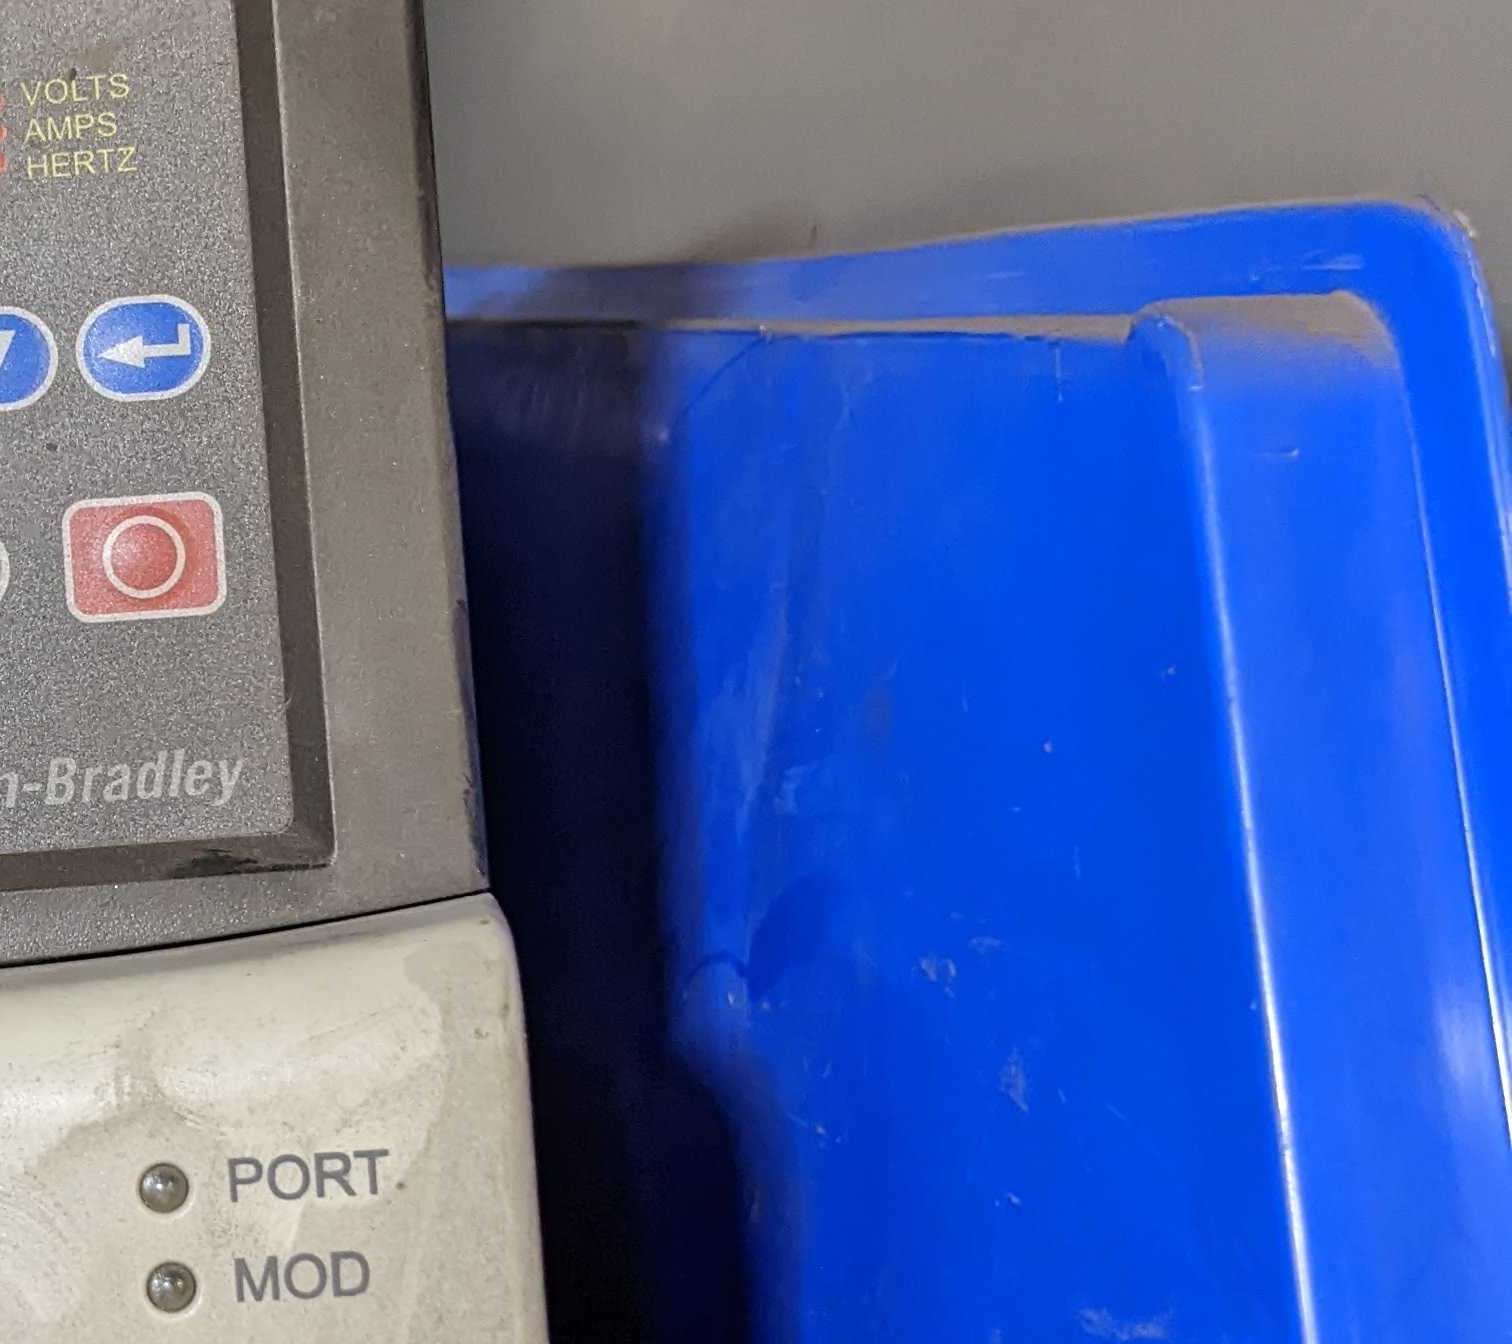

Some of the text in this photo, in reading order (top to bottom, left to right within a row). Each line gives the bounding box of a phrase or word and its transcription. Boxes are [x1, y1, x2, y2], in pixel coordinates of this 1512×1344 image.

[21, 73, 130, 106] VOLTS
[24, 112, 118, 143] AMPS
[26, 146, 138, 178] HERTZ
[227, 1148, 390, 1203] PORT
[233, 1250, 370, 1303] MOD
